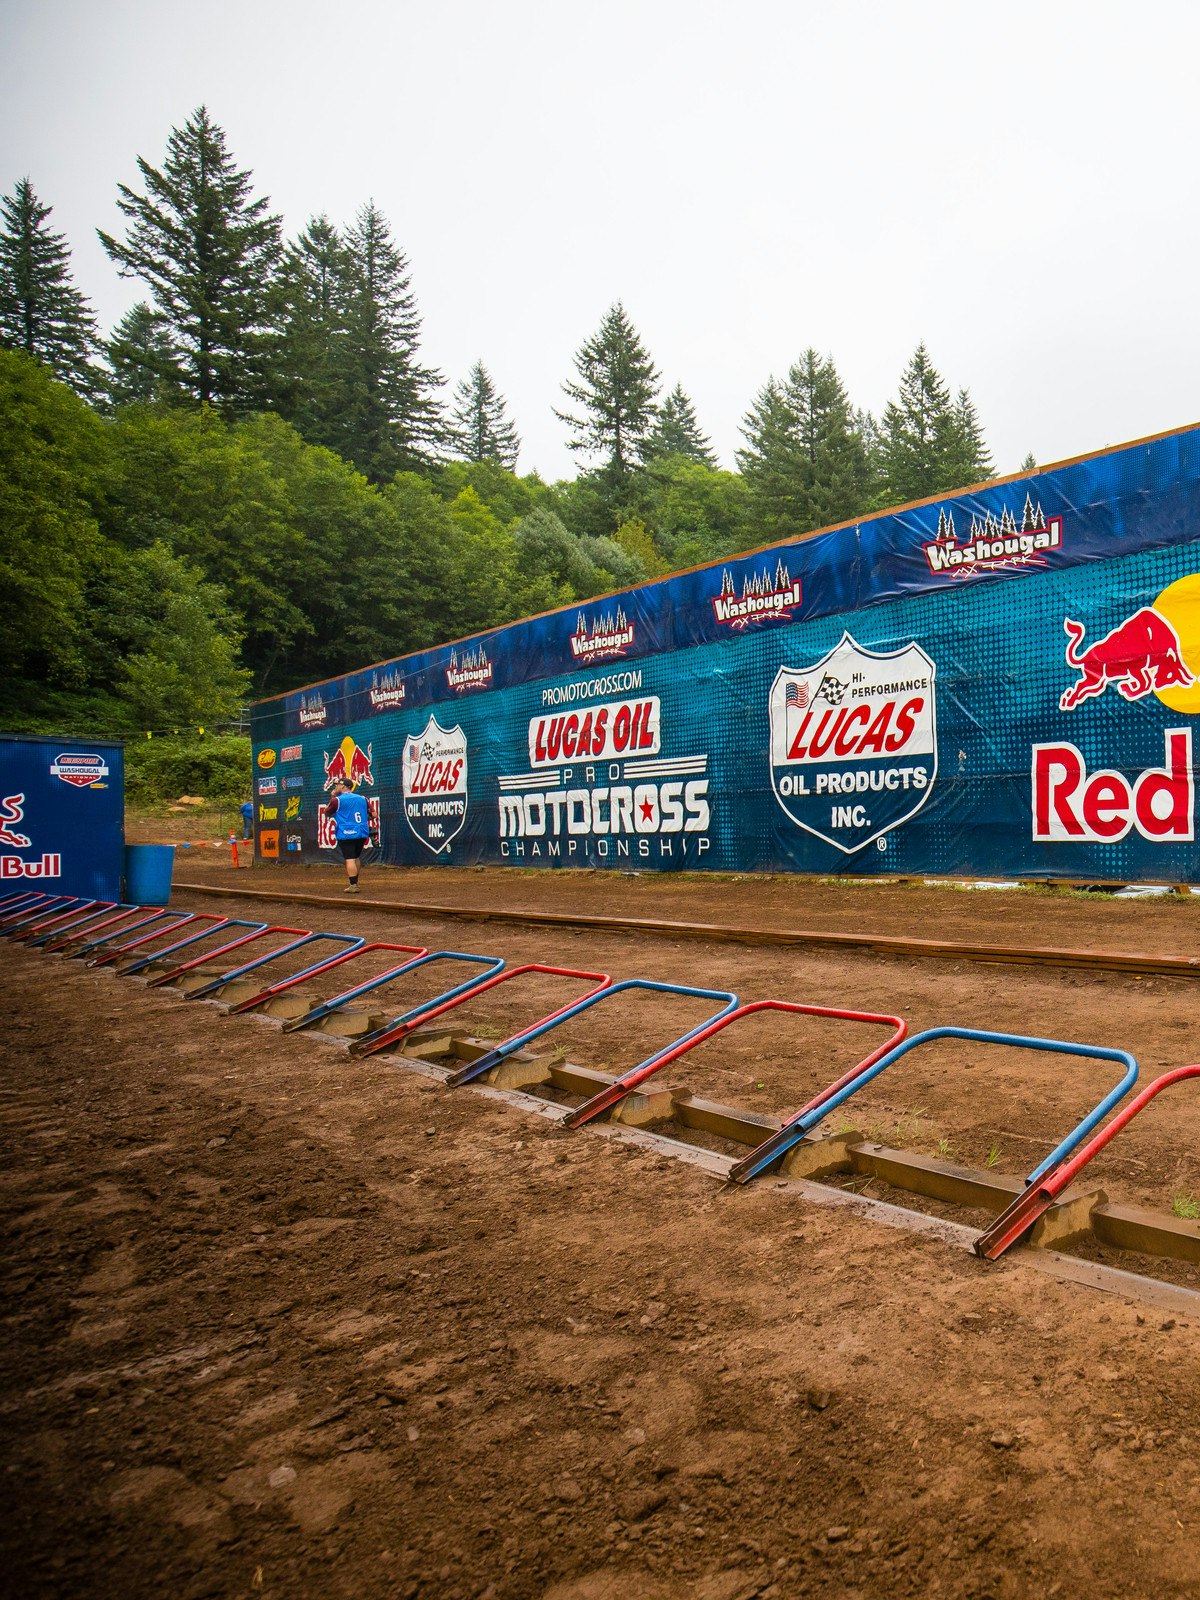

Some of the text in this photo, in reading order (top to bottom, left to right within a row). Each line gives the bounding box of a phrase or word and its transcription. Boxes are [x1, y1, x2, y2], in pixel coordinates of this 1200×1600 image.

[926, 521, 1060, 571] Washougal
[951, 563, 978, 579] MX
[714, 583, 800, 621] Washougal
[731, 615, 750, 629] MX
[570, 626, 633, 656] Washougal
[446, 661, 492, 687] Washougal
[370, 685, 406, 705] Washougal
[541, 670, 642, 706] PROMOTOCROSS.COM
[851, 678, 928, 699] PERFORMANCE
[534, 702, 655, 763] LUCAS OIL
[786, 697, 925, 760] LUCAS
[411, 758, 464, 794] LUCAS
[563, 764, 620, 785] PRO
[779, 766, 928, 796] OIL PRODUCTS
[1032, 727, 1195, 842] Red
[354, 811, 362, 824] 6
[407, 800, 464, 818] OIL PRODUCTS
[498, 779, 711, 837] MOTOCROSS
[831, 805, 872, 828] INC.
[428, 823, 445, 838] INC.
[500, 838, 711, 857] CHAMPIONSHIP
[0, 853, 61, 879] Bull
